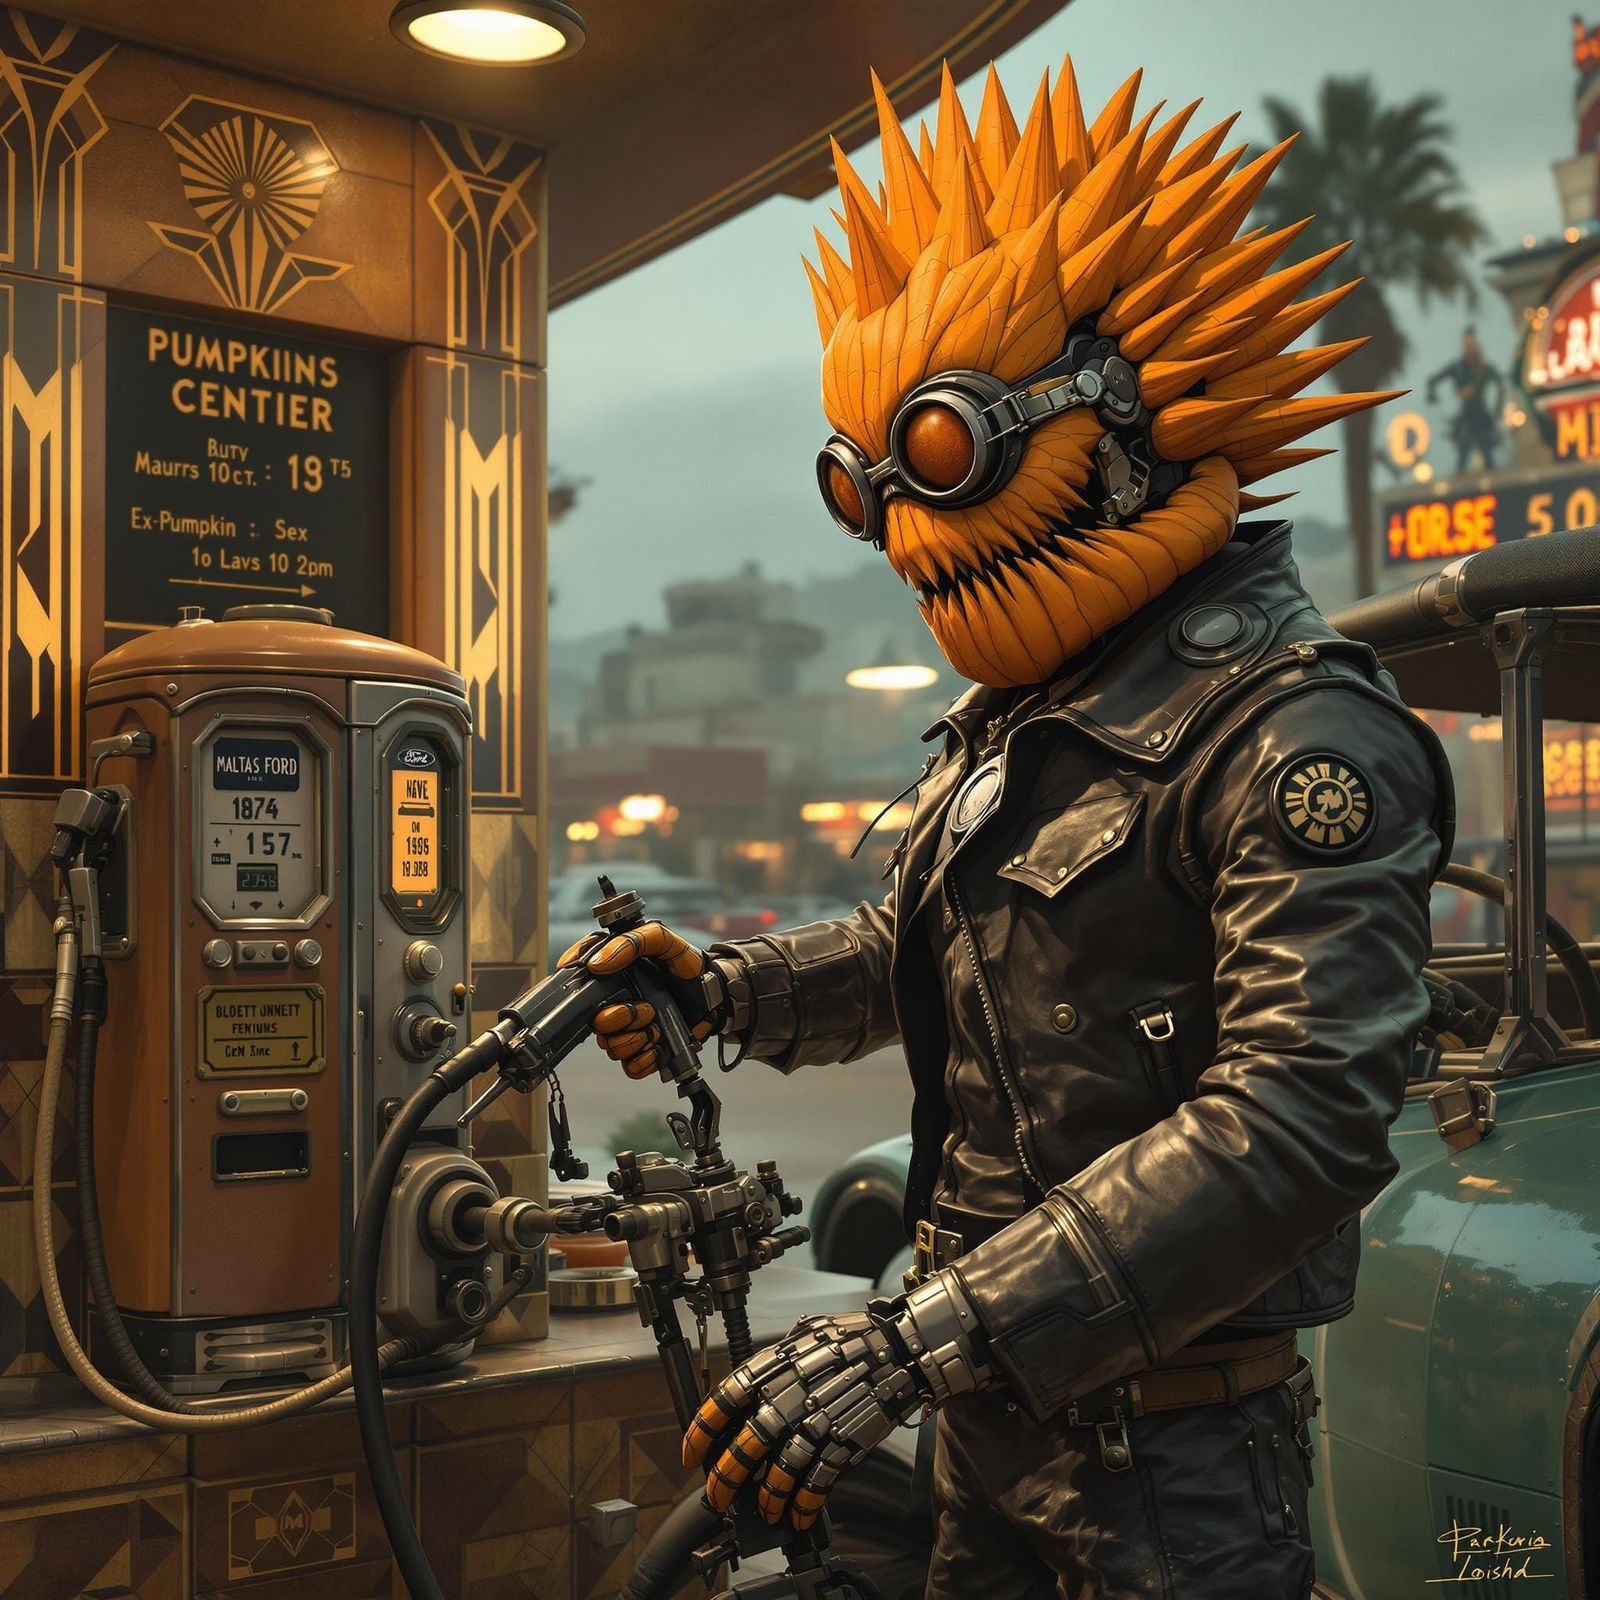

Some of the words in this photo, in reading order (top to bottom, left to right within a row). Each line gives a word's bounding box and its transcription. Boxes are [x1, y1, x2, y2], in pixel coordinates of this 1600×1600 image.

[147, 327, 339, 388] PUMPKIINS
[171, 378, 334, 432] CENTIER
[134, 451, 200, 479] Maurrs
[287, 453, 324, 493] 19
[274, 519, 309, 541] Sex
[219, 548, 261, 571] Lavs
[296, 555, 334, 578] 2pm
[216, 755, 260, 774] MALTAS
[264, 757, 298, 776] FORD
[232, 796, 279, 820] 1874
